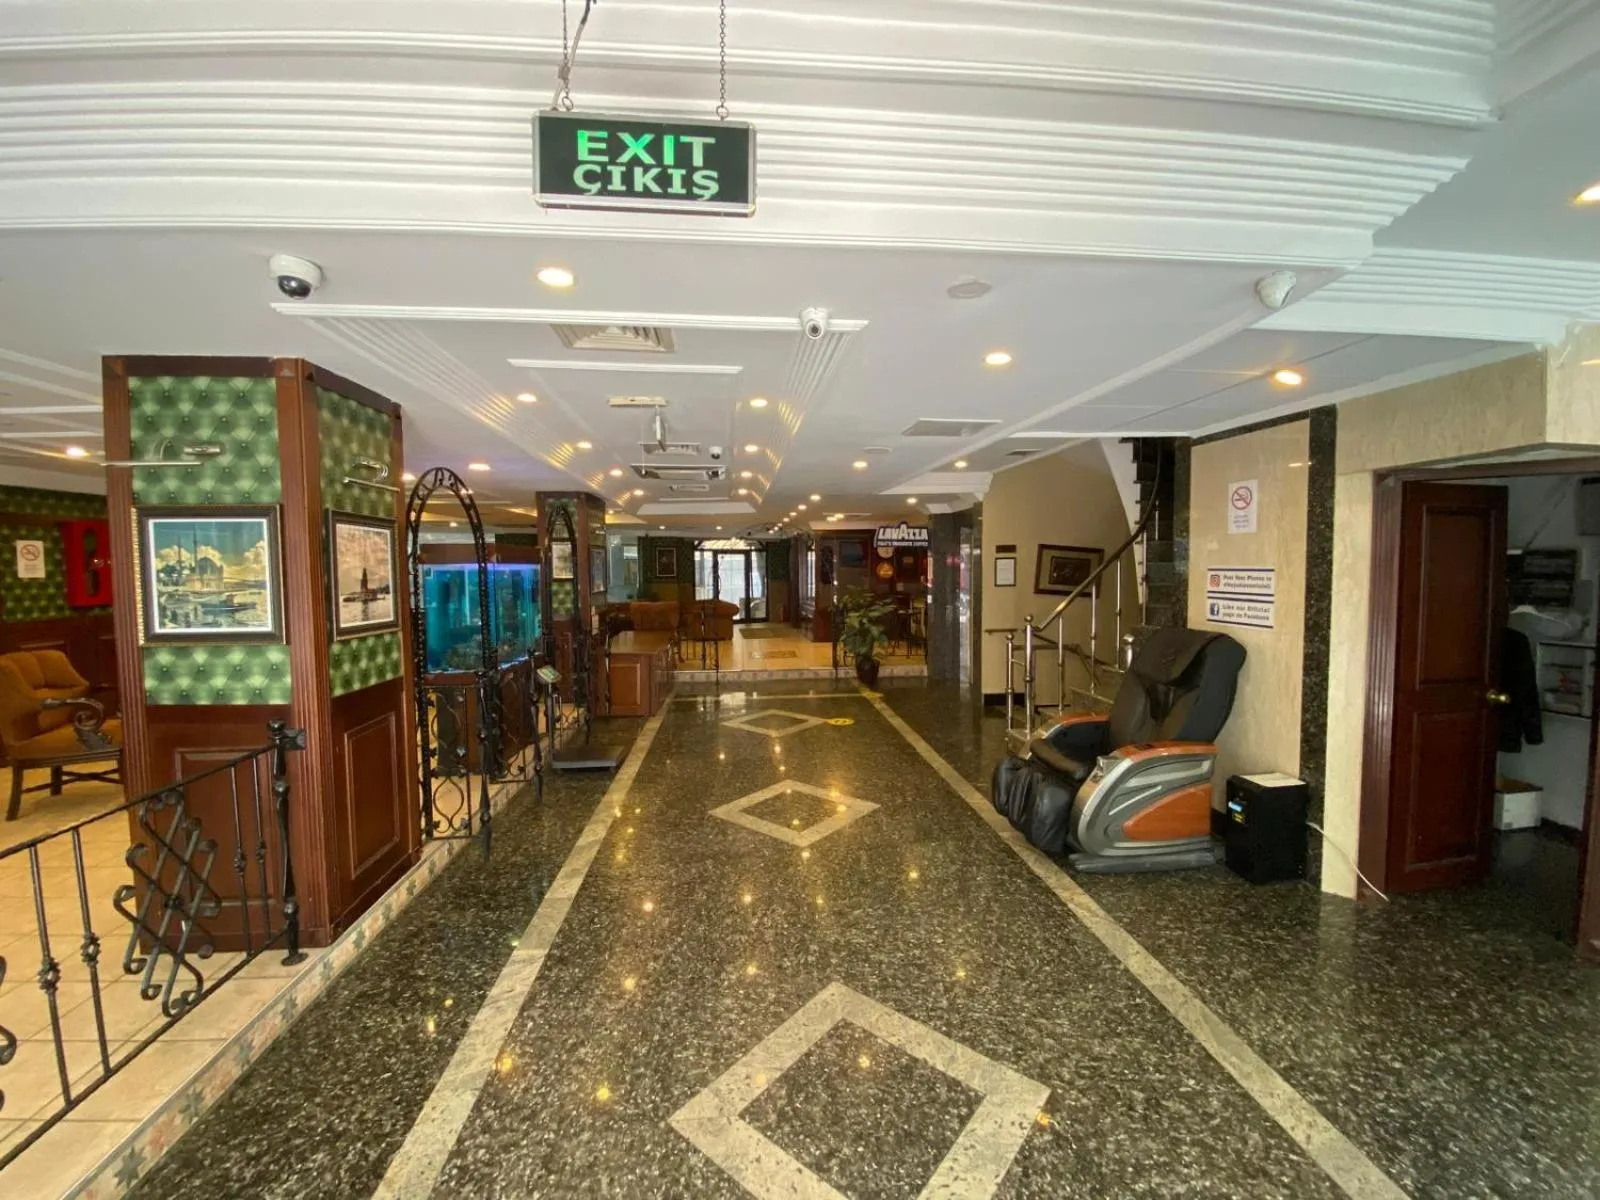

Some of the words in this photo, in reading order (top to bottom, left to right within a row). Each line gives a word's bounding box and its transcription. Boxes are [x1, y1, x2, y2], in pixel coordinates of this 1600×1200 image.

[577, 129, 716, 167] EXIT
[573, 164, 720, 201] ÇIKIŞ
[878, 524, 928, 540] LAVAZZA
